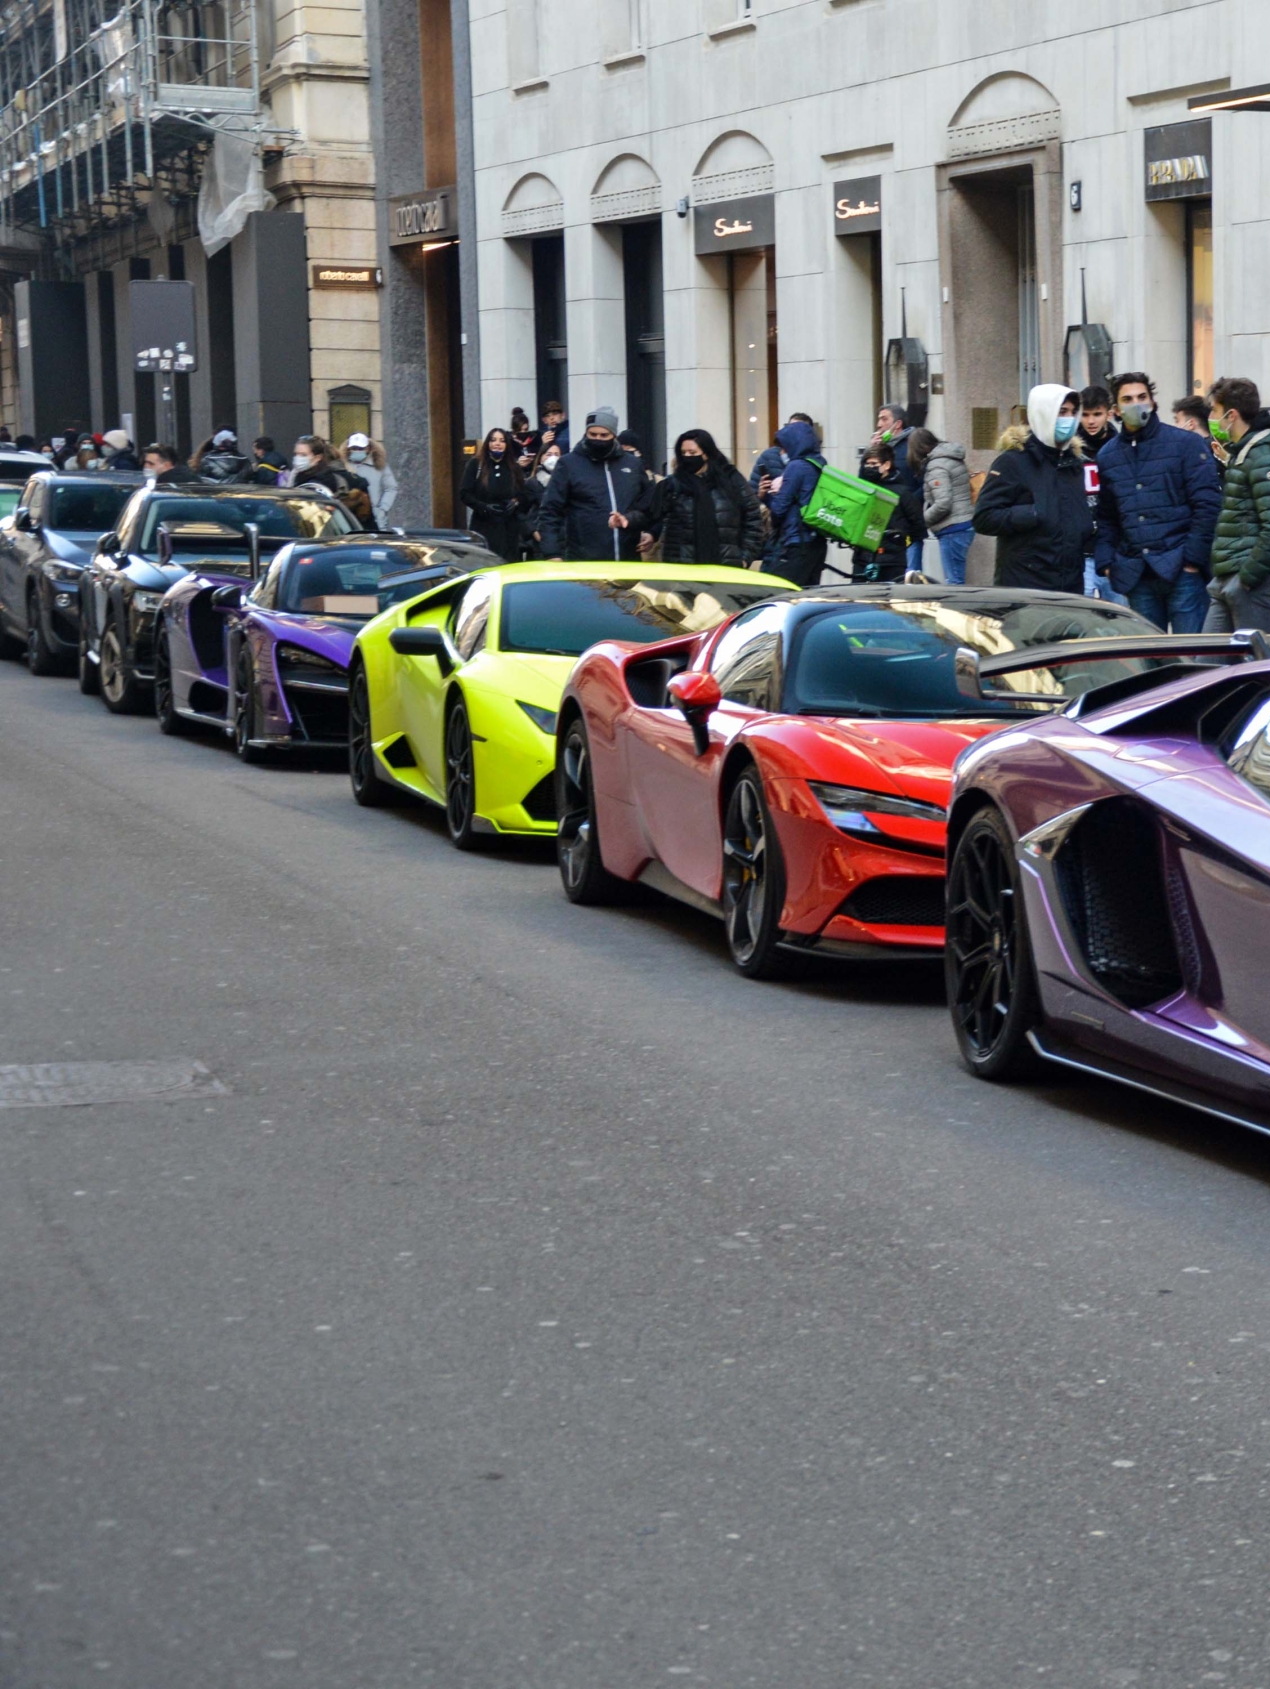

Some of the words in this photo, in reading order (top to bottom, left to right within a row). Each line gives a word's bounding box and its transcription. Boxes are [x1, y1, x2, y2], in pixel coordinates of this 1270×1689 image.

[1148, 155, 1209, 186] PRADA
[835, 199, 881, 219] Santoni
[714, 218, 753, 237] Santoni
[816, 508, 843, 527] Eats
